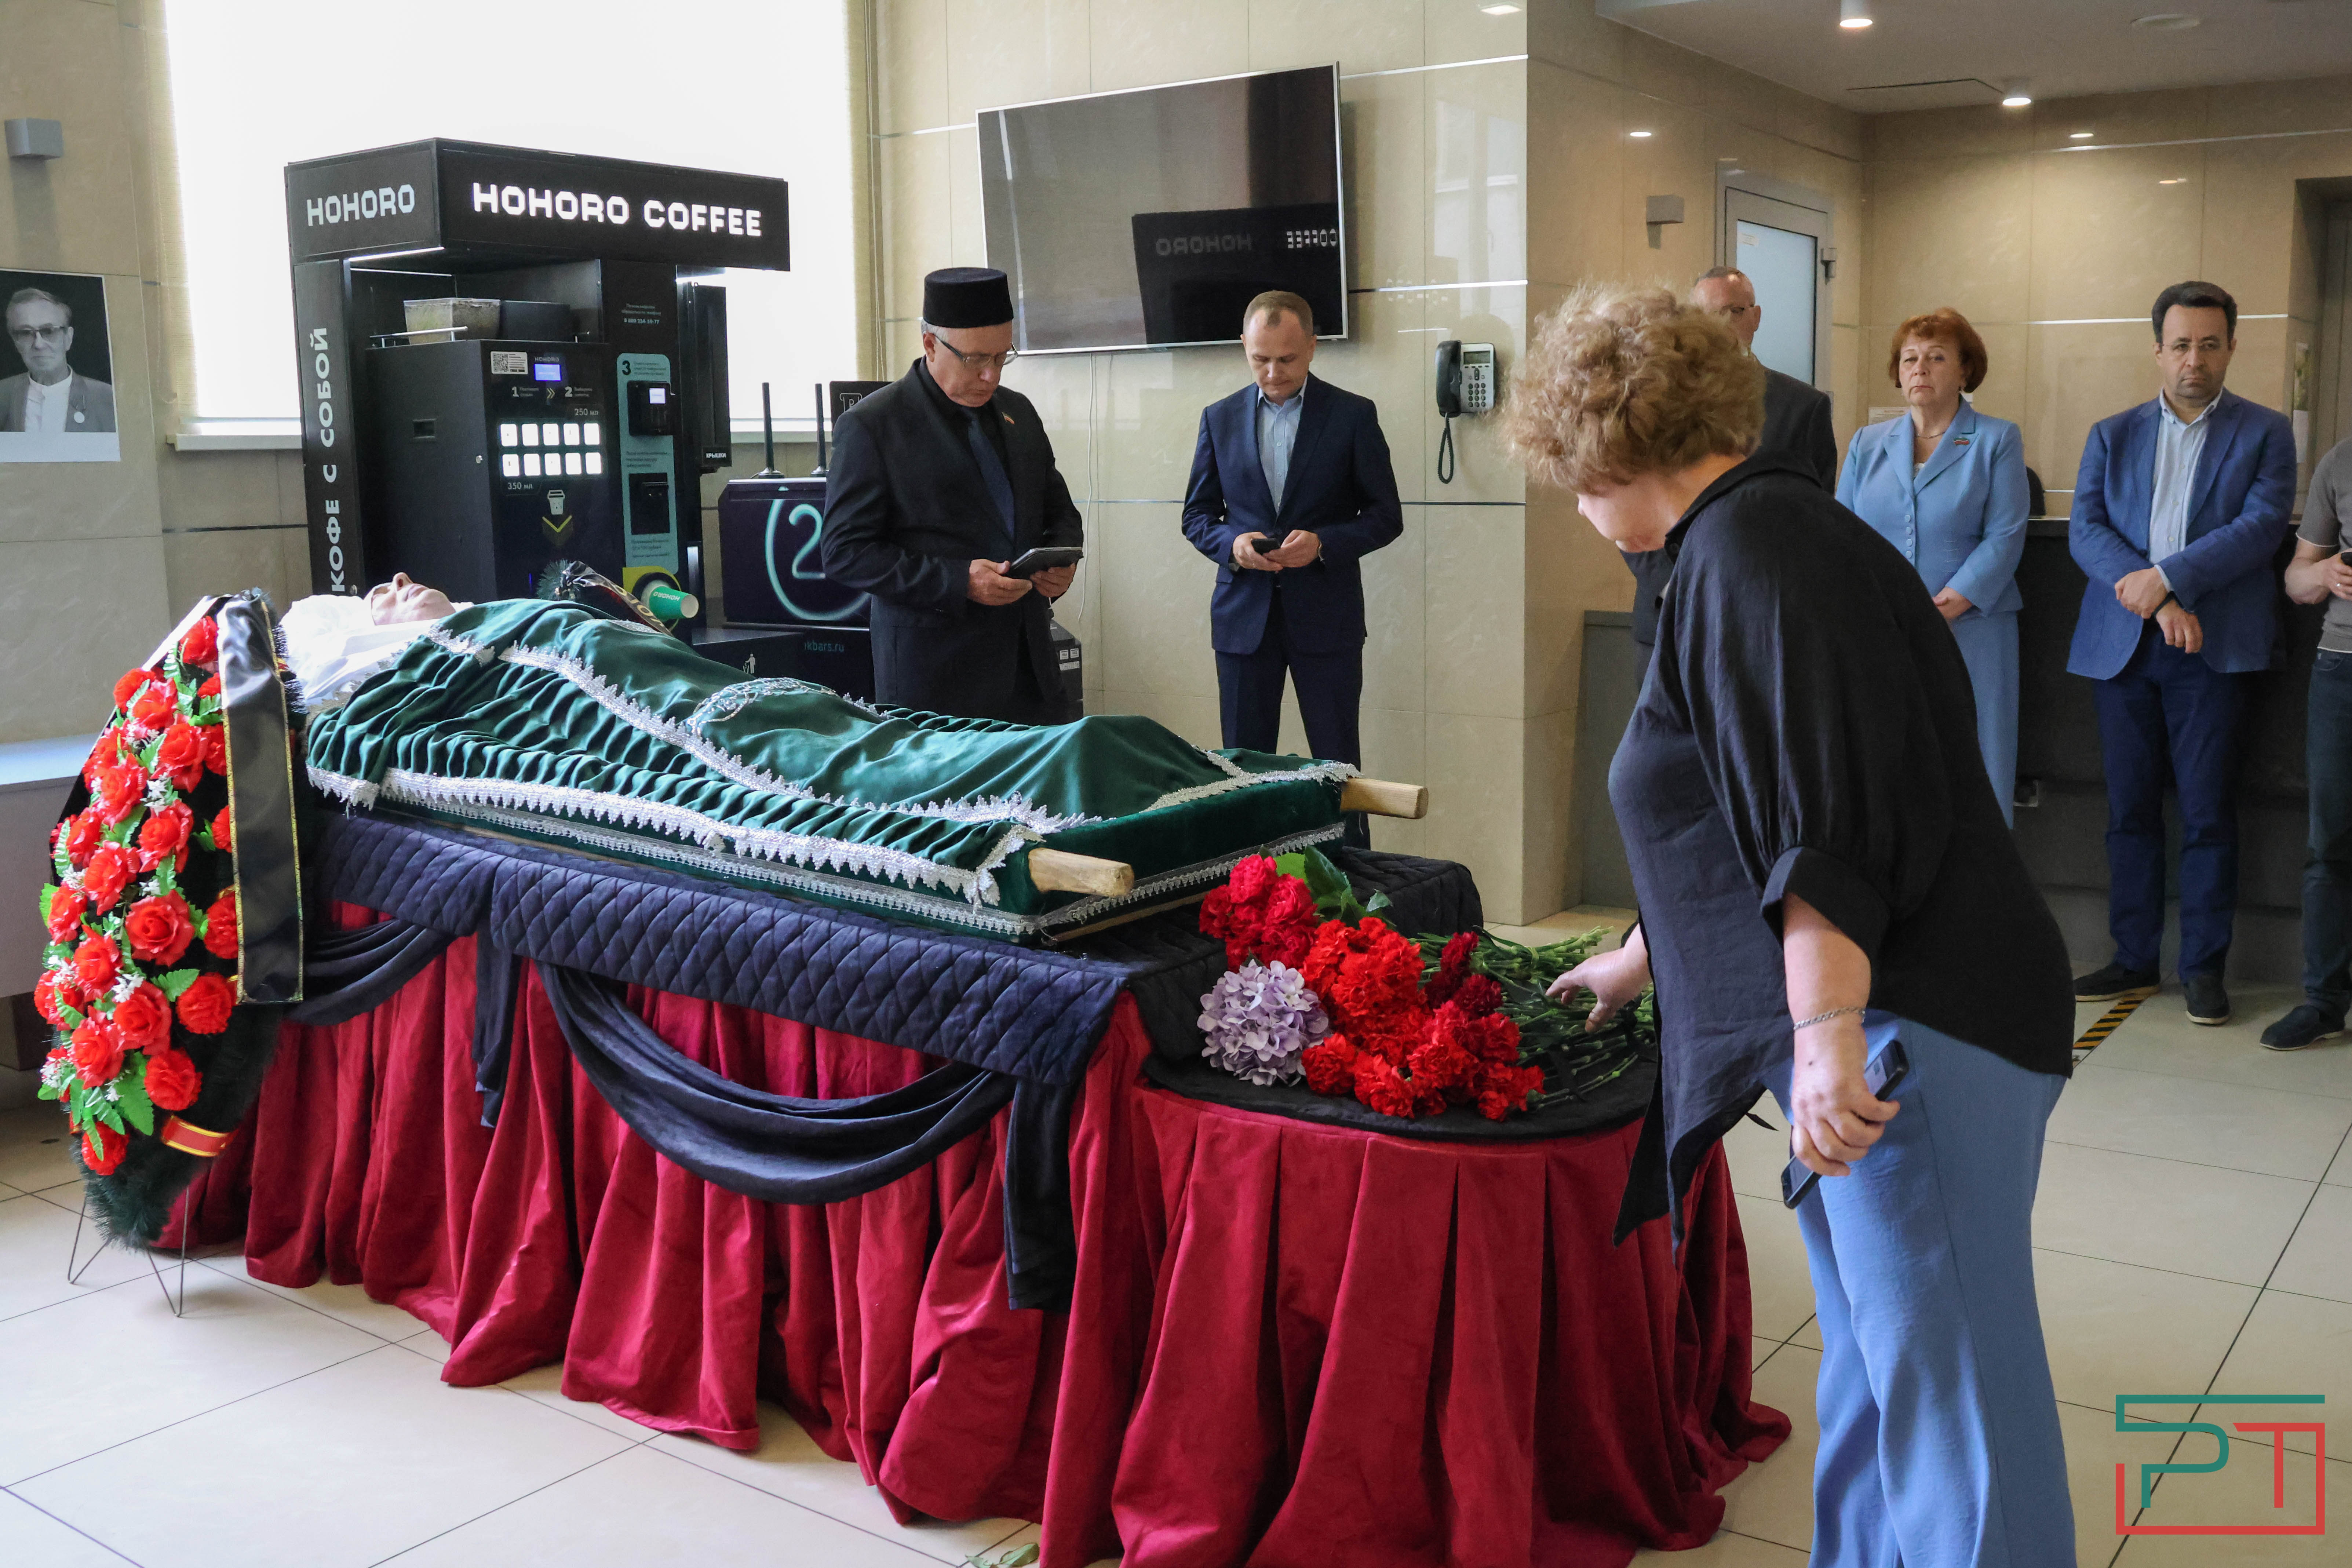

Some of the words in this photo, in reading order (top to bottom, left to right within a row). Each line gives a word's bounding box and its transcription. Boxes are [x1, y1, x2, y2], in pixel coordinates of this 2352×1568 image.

[307, 184, 415, 227] HOHORO
[473, 182, 630, 225] HOHORO
[644, 200, 762, 237] COFFEE
[622, 360, 631, 375] 3
[310, 327, 335, 448] СОБОЙ
[511, 386, 519, 397] 1
[565, 386, 573, 397] 2
[574, 408, 588, 416] 250
[325, 499, 345, 592] КОФЕ
